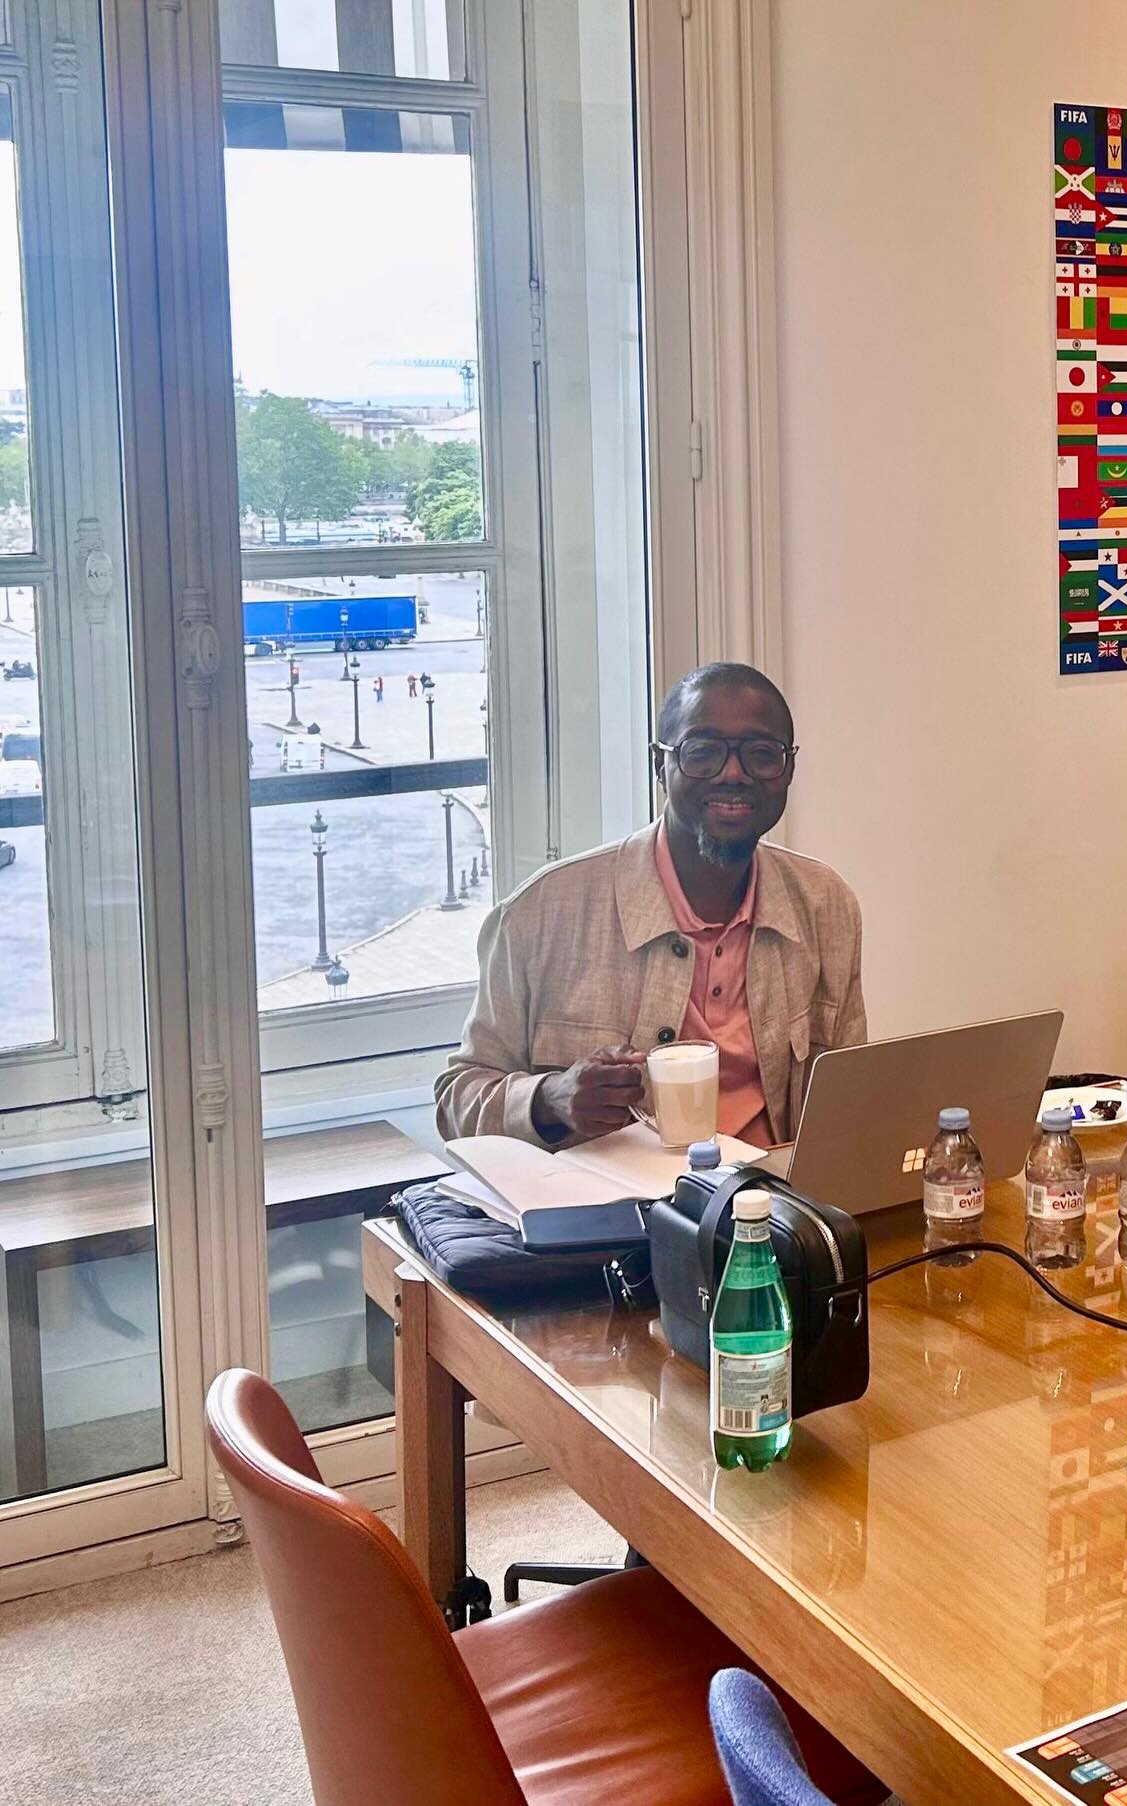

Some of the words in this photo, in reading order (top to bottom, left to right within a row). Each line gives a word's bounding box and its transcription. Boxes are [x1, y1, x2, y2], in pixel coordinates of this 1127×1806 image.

[1060, 109, 1088, 125] FIFA
[1065, 652, 1092, 665] FIFA
[1052, 1196, 1083, 1211] evian
